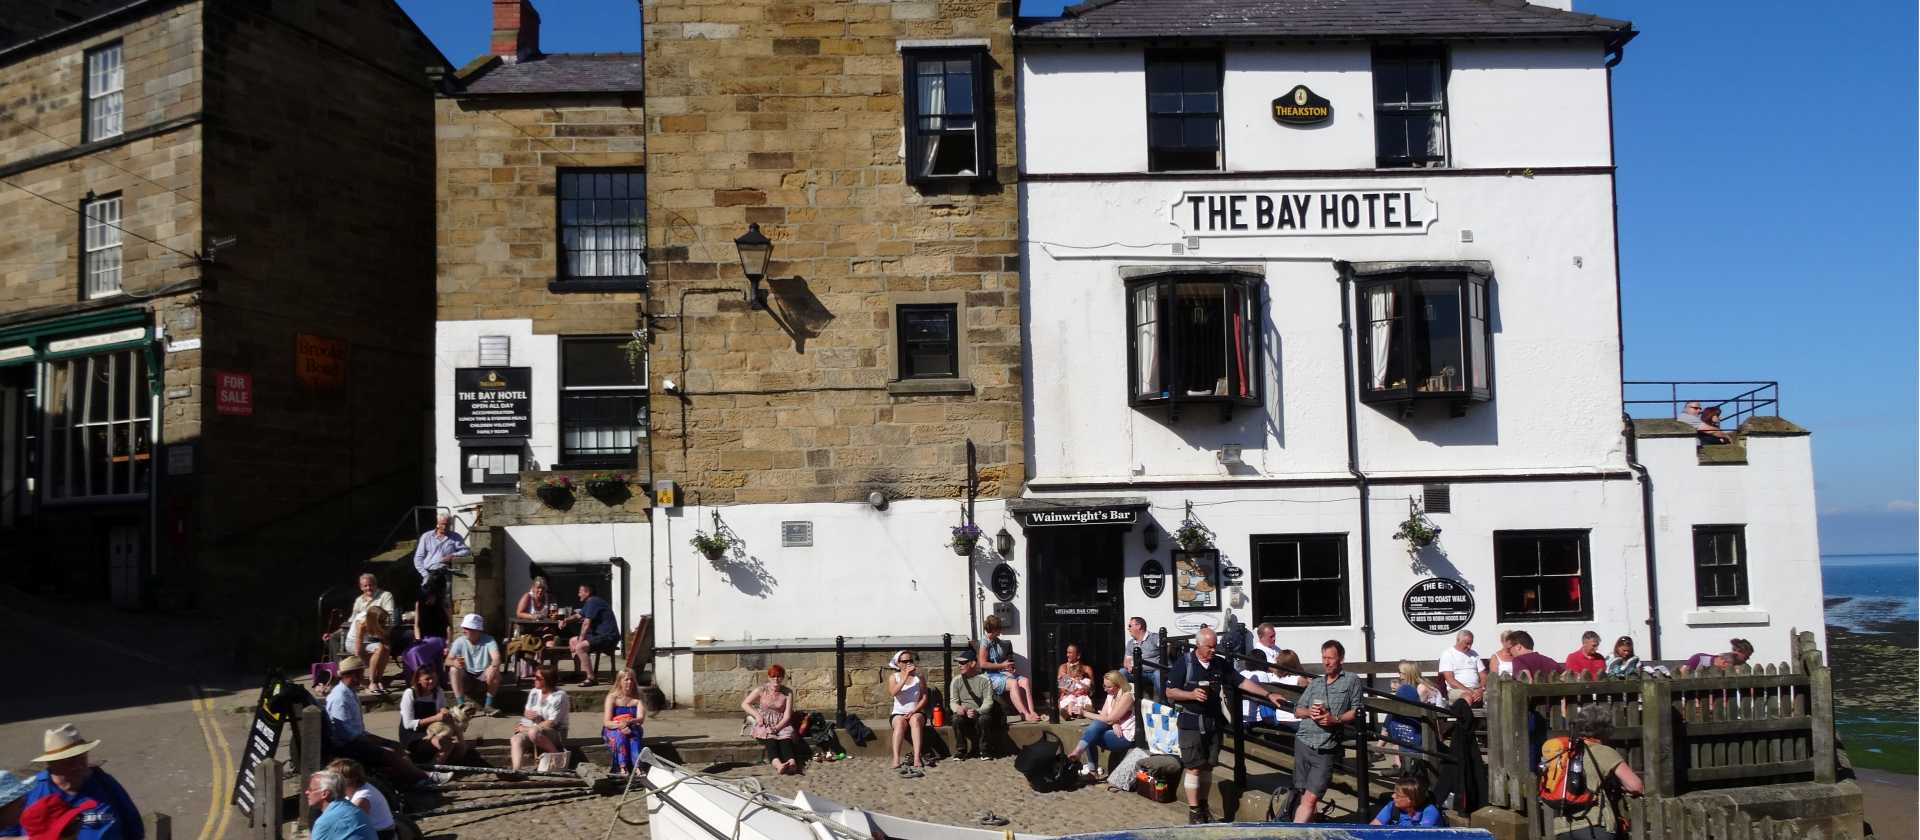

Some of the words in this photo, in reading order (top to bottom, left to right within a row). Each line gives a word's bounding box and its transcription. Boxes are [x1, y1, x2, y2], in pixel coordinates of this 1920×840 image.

[1275, 105, 1328, 116] THEAKSTON
[1186, 194, 1248, 231] THE
[1255, 193, 1312, 230] BAY
[1319, 192, 1423, 230] HOTEL
[223, 375, 245, 390] FOR
[220, 390, 249, 404] SALE
[458, 392, 477, 400] THE
[478, 391, 496, 400] BAY
[497, 391, 528, 400] HOTEL
[1032, 511, 1108, 523] Wainwright's
[1109, 510, 1131, 520] Bar
[1422, 582, 1436, 591] THE
[1410, 595, 1427, 603] COAST
[1427, 595, 1434, 603] TO
[1434, 595, 1451, 603] COAST
